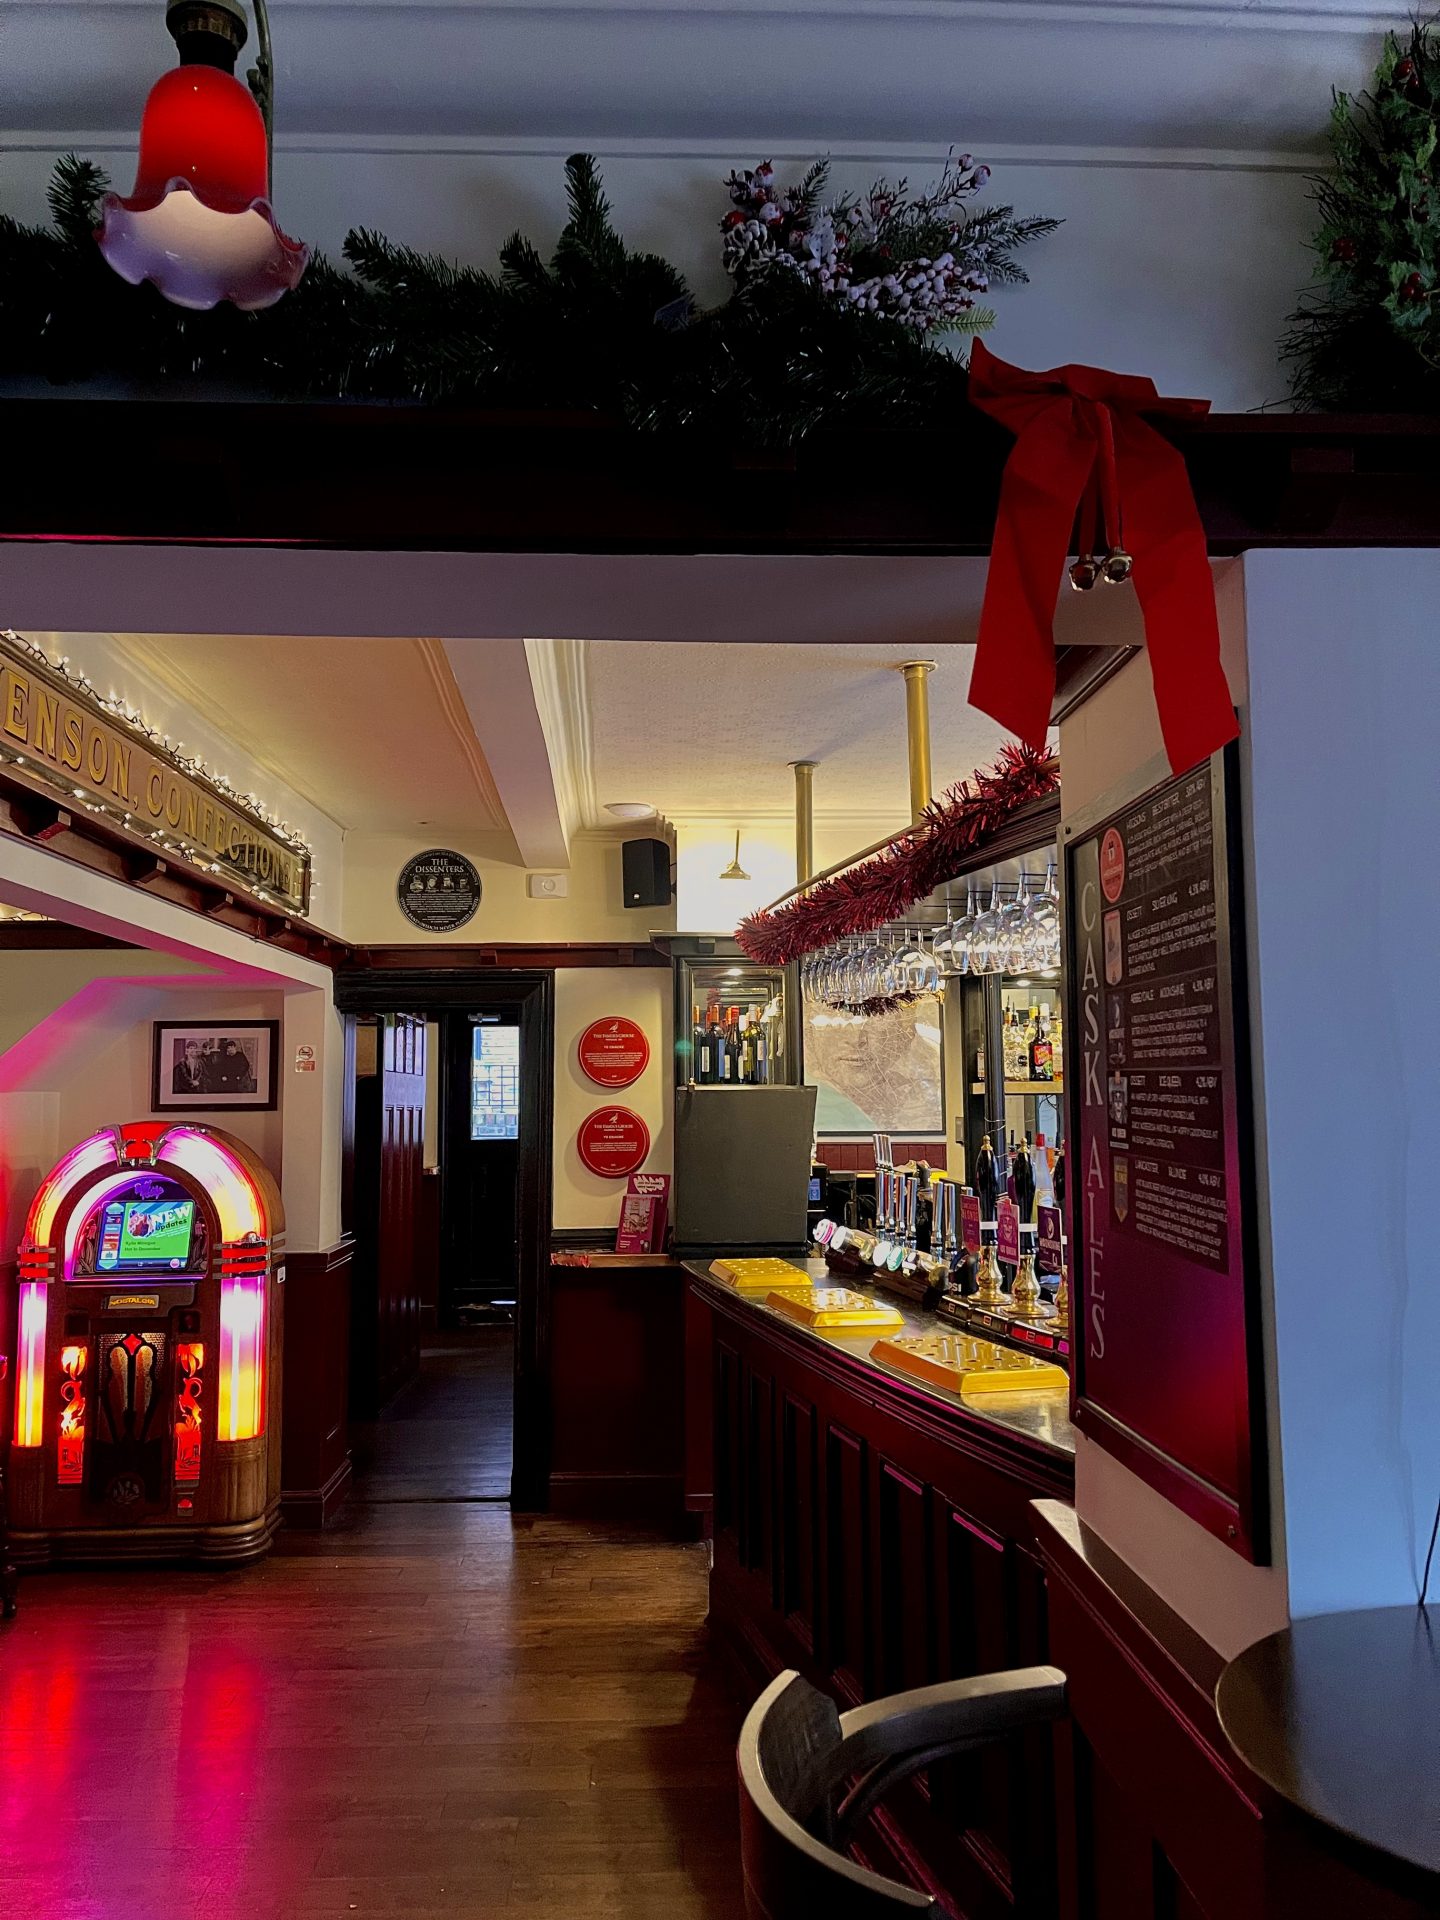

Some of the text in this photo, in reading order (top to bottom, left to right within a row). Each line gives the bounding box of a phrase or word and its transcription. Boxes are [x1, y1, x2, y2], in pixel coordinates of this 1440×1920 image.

[0, 664, 141, 812] ENSON,
[431, 858, 449, 866] THE
[415, 865, 465, 874] DISSENTERS
[151, 1206, 191, 1224] NEW
[155, 1218, 187, 1232] updates
[109, 1296, 156, 1306] NOSTALGIA
